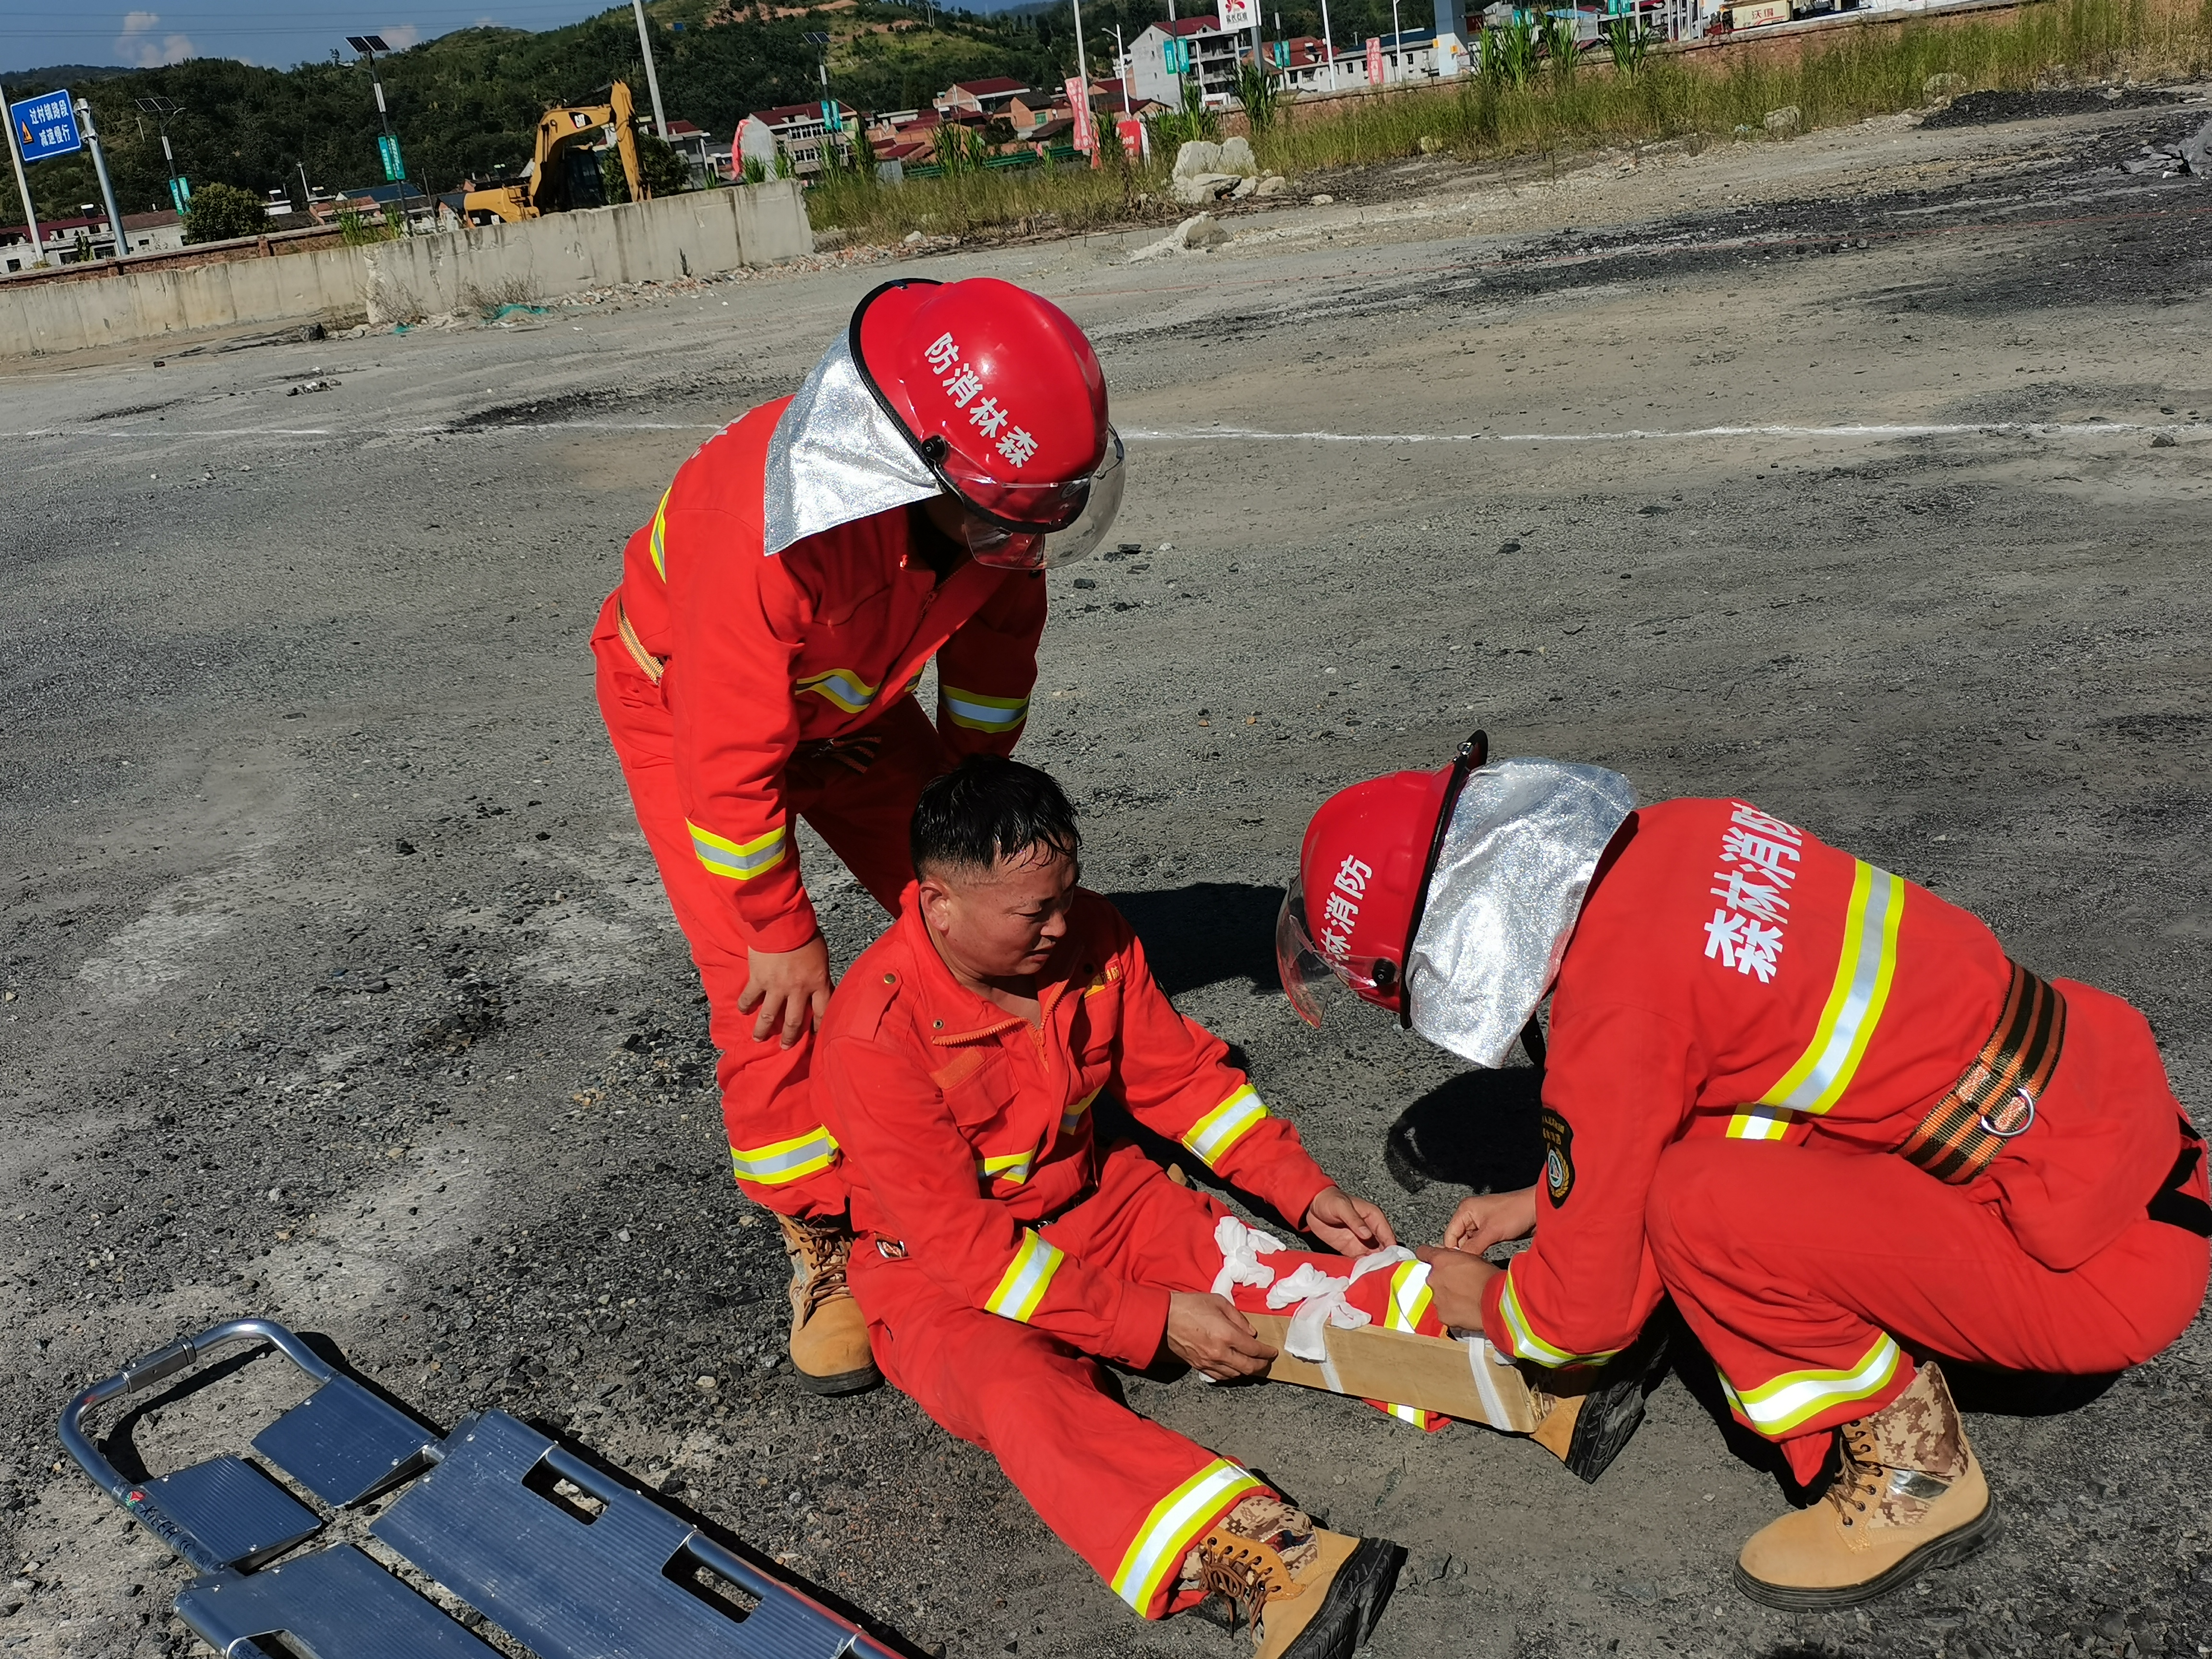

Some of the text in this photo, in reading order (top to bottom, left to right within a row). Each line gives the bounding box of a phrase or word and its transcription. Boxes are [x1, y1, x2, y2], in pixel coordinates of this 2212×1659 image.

[29, 99, 69, 125] 过村镇路段
[39, 124, 71, 147] 减速慢行
